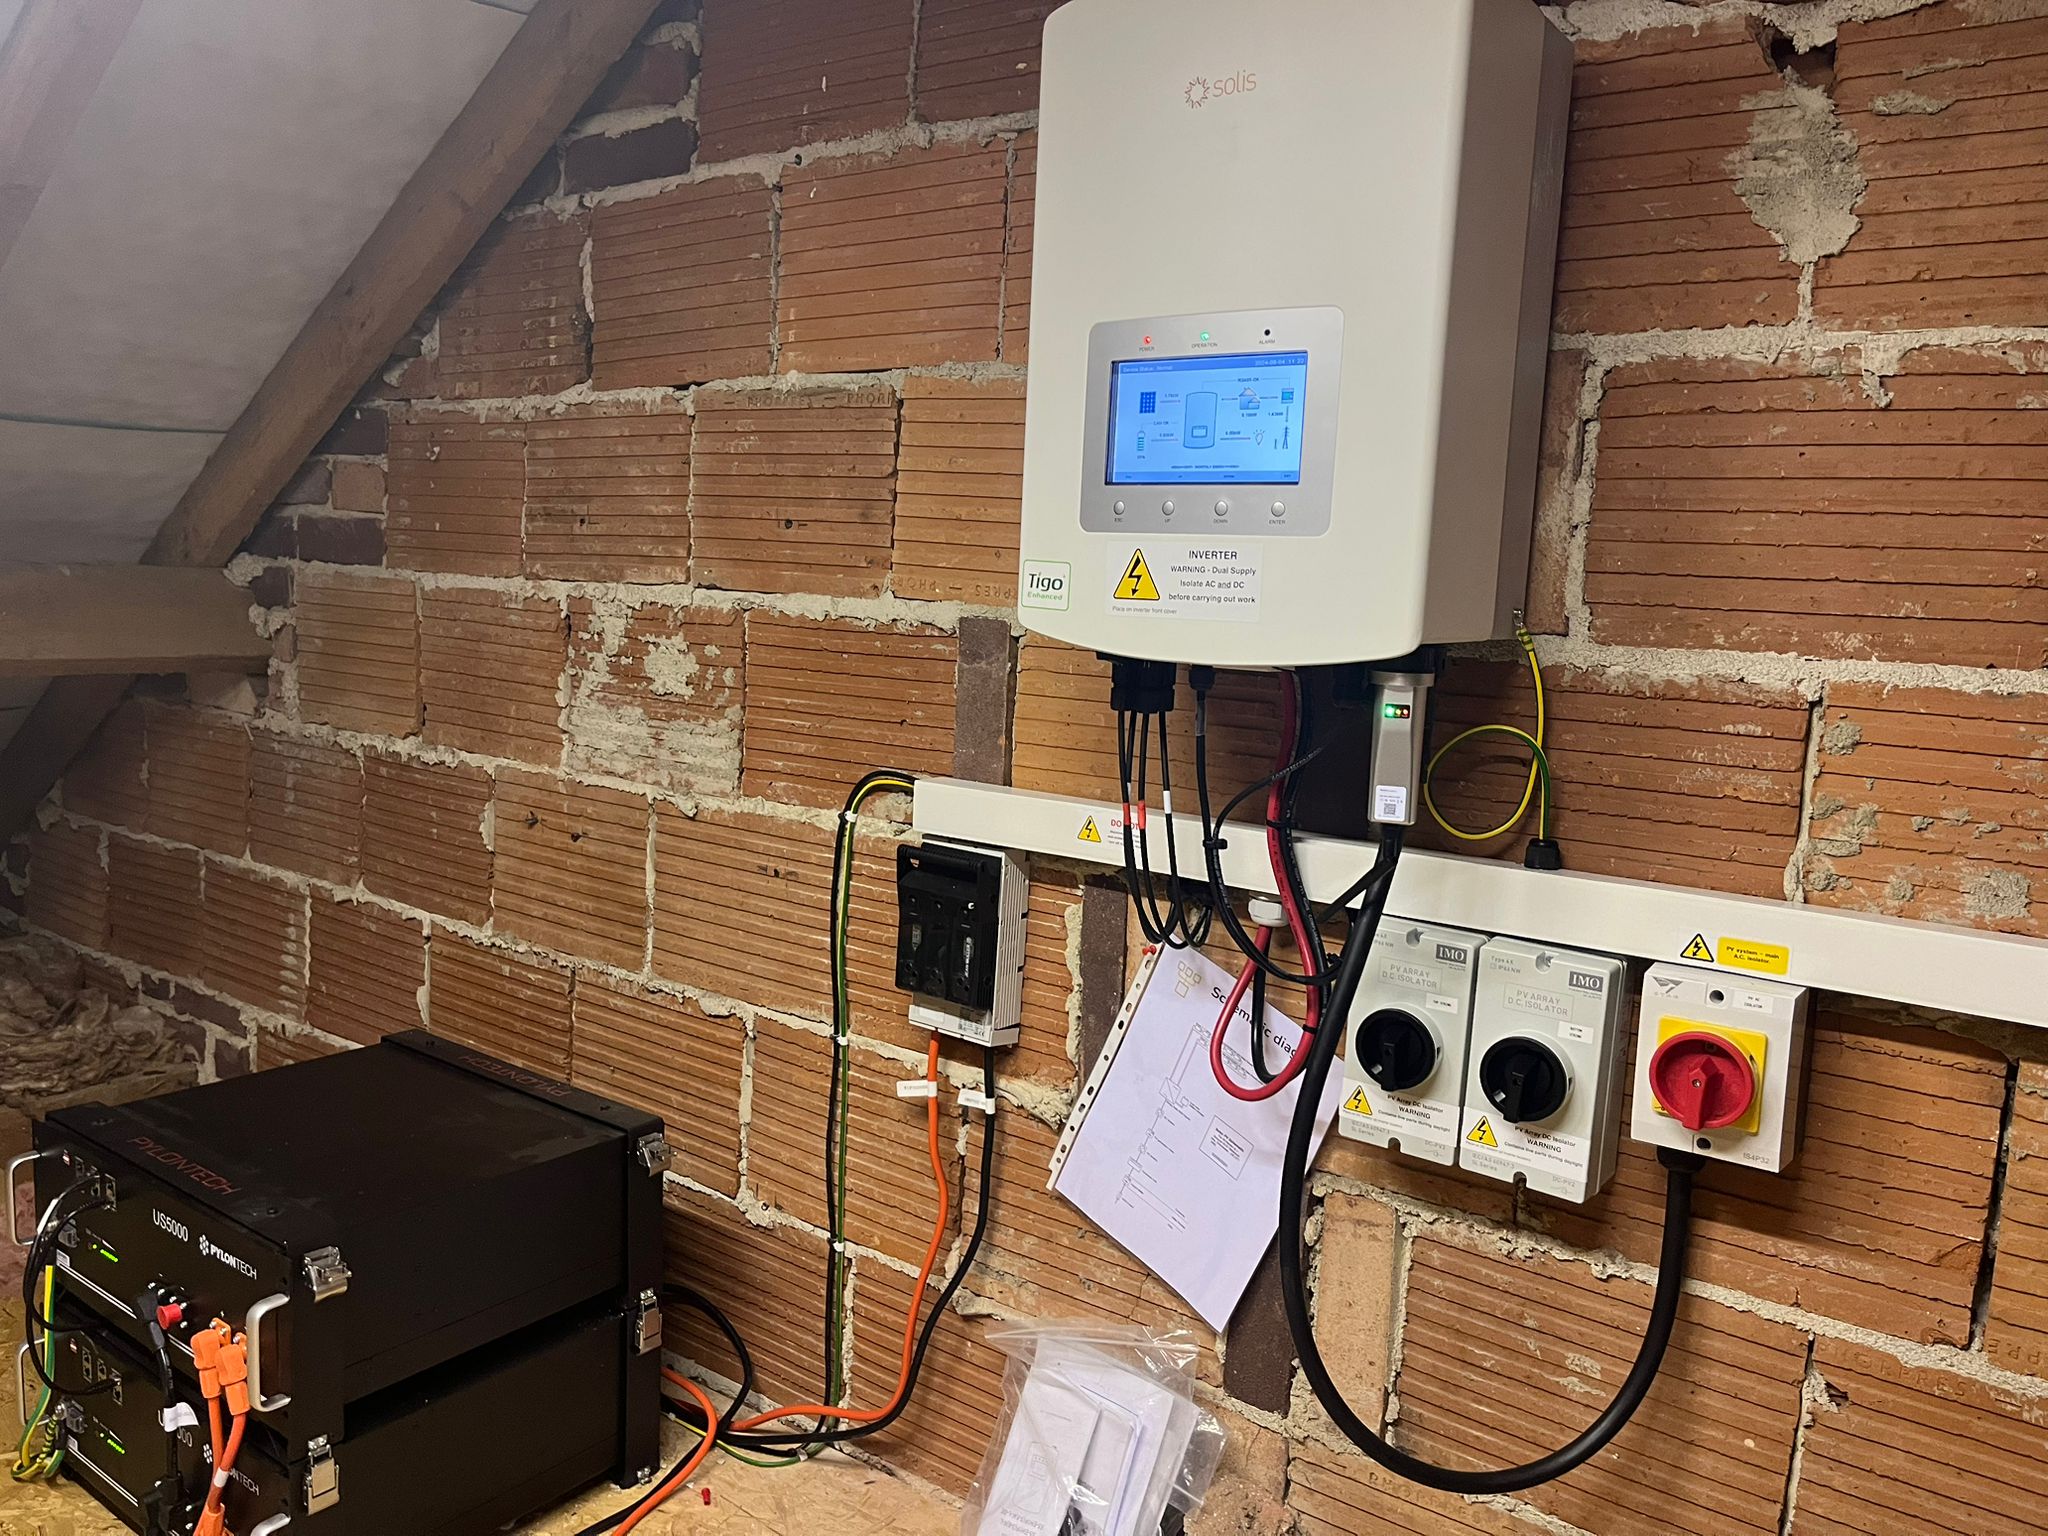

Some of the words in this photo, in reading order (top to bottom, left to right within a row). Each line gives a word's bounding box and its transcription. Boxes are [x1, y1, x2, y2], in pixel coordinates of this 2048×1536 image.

[1212, 69, 1257, 98] solis
[1188, 550, 1238, 560] INVERTER
[1170, 565, 1206, 574] WARNING
[1212, 566, 1229, 574] Dual
[1230, 566, 1257, 577] Supply
[1028, 571, 1064, 592] Tigo
[1180, 580, 1204, 588] Isolate
[1204, 580, 1216, 588] AC
[1217, 581, 1231, 589] and
[1233, 581, 1245, 589] DC
[1027, 591, 1063, 601] Enhanced
[1168, 593, 1191, 601] before
[1192, 594, 1222, 604] carrying
[1223, 595, 1236, 603] out
[1110, 819, 1122, 828] DO
[1439, 946, 1465, 961] IMO
[1390, 964, 1401, 973] PV
[1402, 967, 1430, 979] ARRAY
[1398, 974, 1438, 989] ISOLATOR
[1572, 974, 1600, 989] IMO
[1516, 989, 1529, 999] PV
[1530, 993, 1561, 1005] ARRAY
[1524, 1000, 1568, 1016] ISOLATOR
[1211, 986, 1272, 1038] Scemic
[1273, 1034, 1299, 1060] diag
[1387, 1093, 1395, 1101] PV
[1396, 1096, 1411, 1106] Array
[1412, 1100, 1421, 1108] DC
[1422, 1103, 1444, 1113] Isolator
[1398, 1105, 1431, 1120] WARNING
[1524, 1128, 1541, 1139] Array
[1542, 1133, 1552, 1141] DC
[1552, 1136, 1576, 1147] Isolator
[1526, 1137, 1562, 1153] WARNING
[128, 1136, 242, 1195] PYLONTECH
[152, 1208, 189, 1242] US5000
[210, 1243, 258, 1280] PYLONTECH
